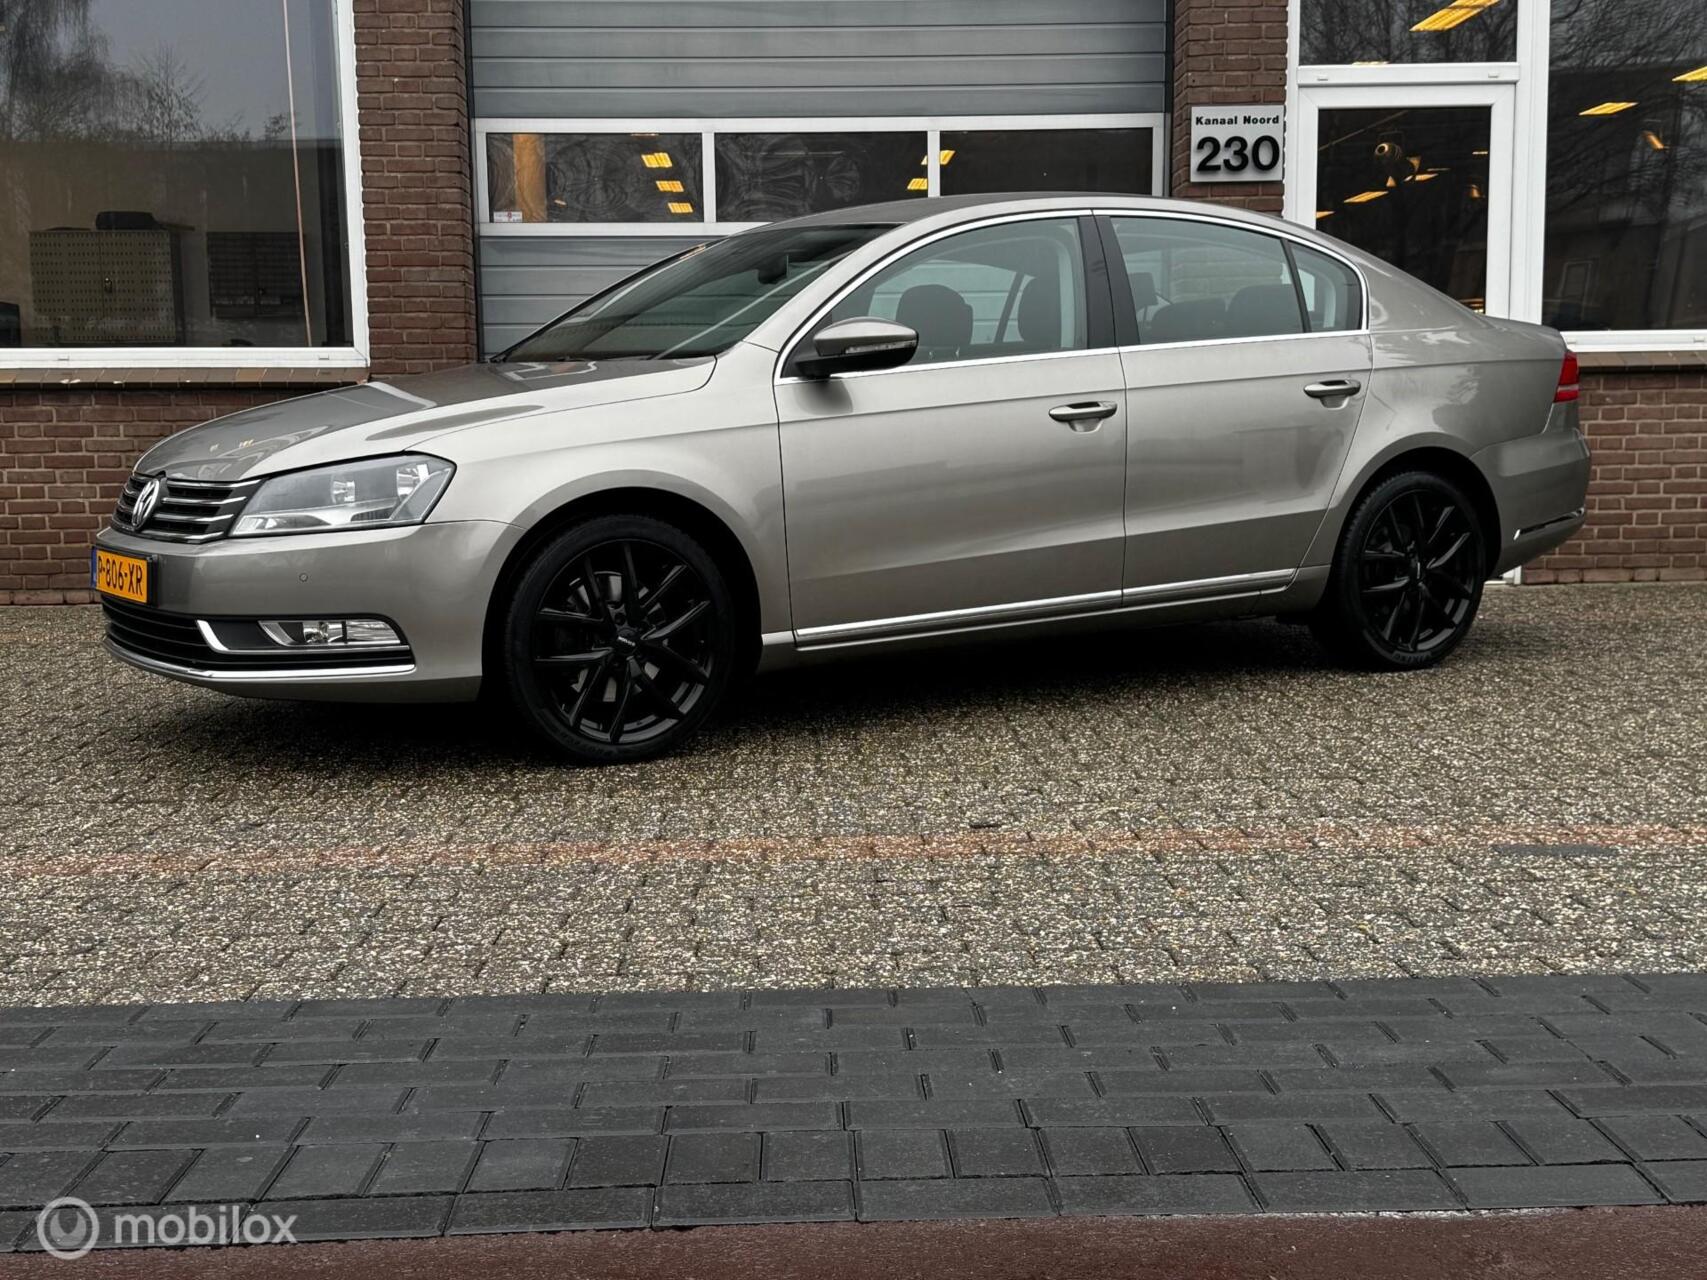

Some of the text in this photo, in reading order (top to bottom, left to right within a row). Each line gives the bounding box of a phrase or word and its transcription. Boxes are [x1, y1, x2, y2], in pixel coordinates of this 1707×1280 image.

[1195, 115, 1280, 126] Kanaal Noord
[1196, 135, 1280, 172] 230
[97, 555, 144, 597] P-806-XR
